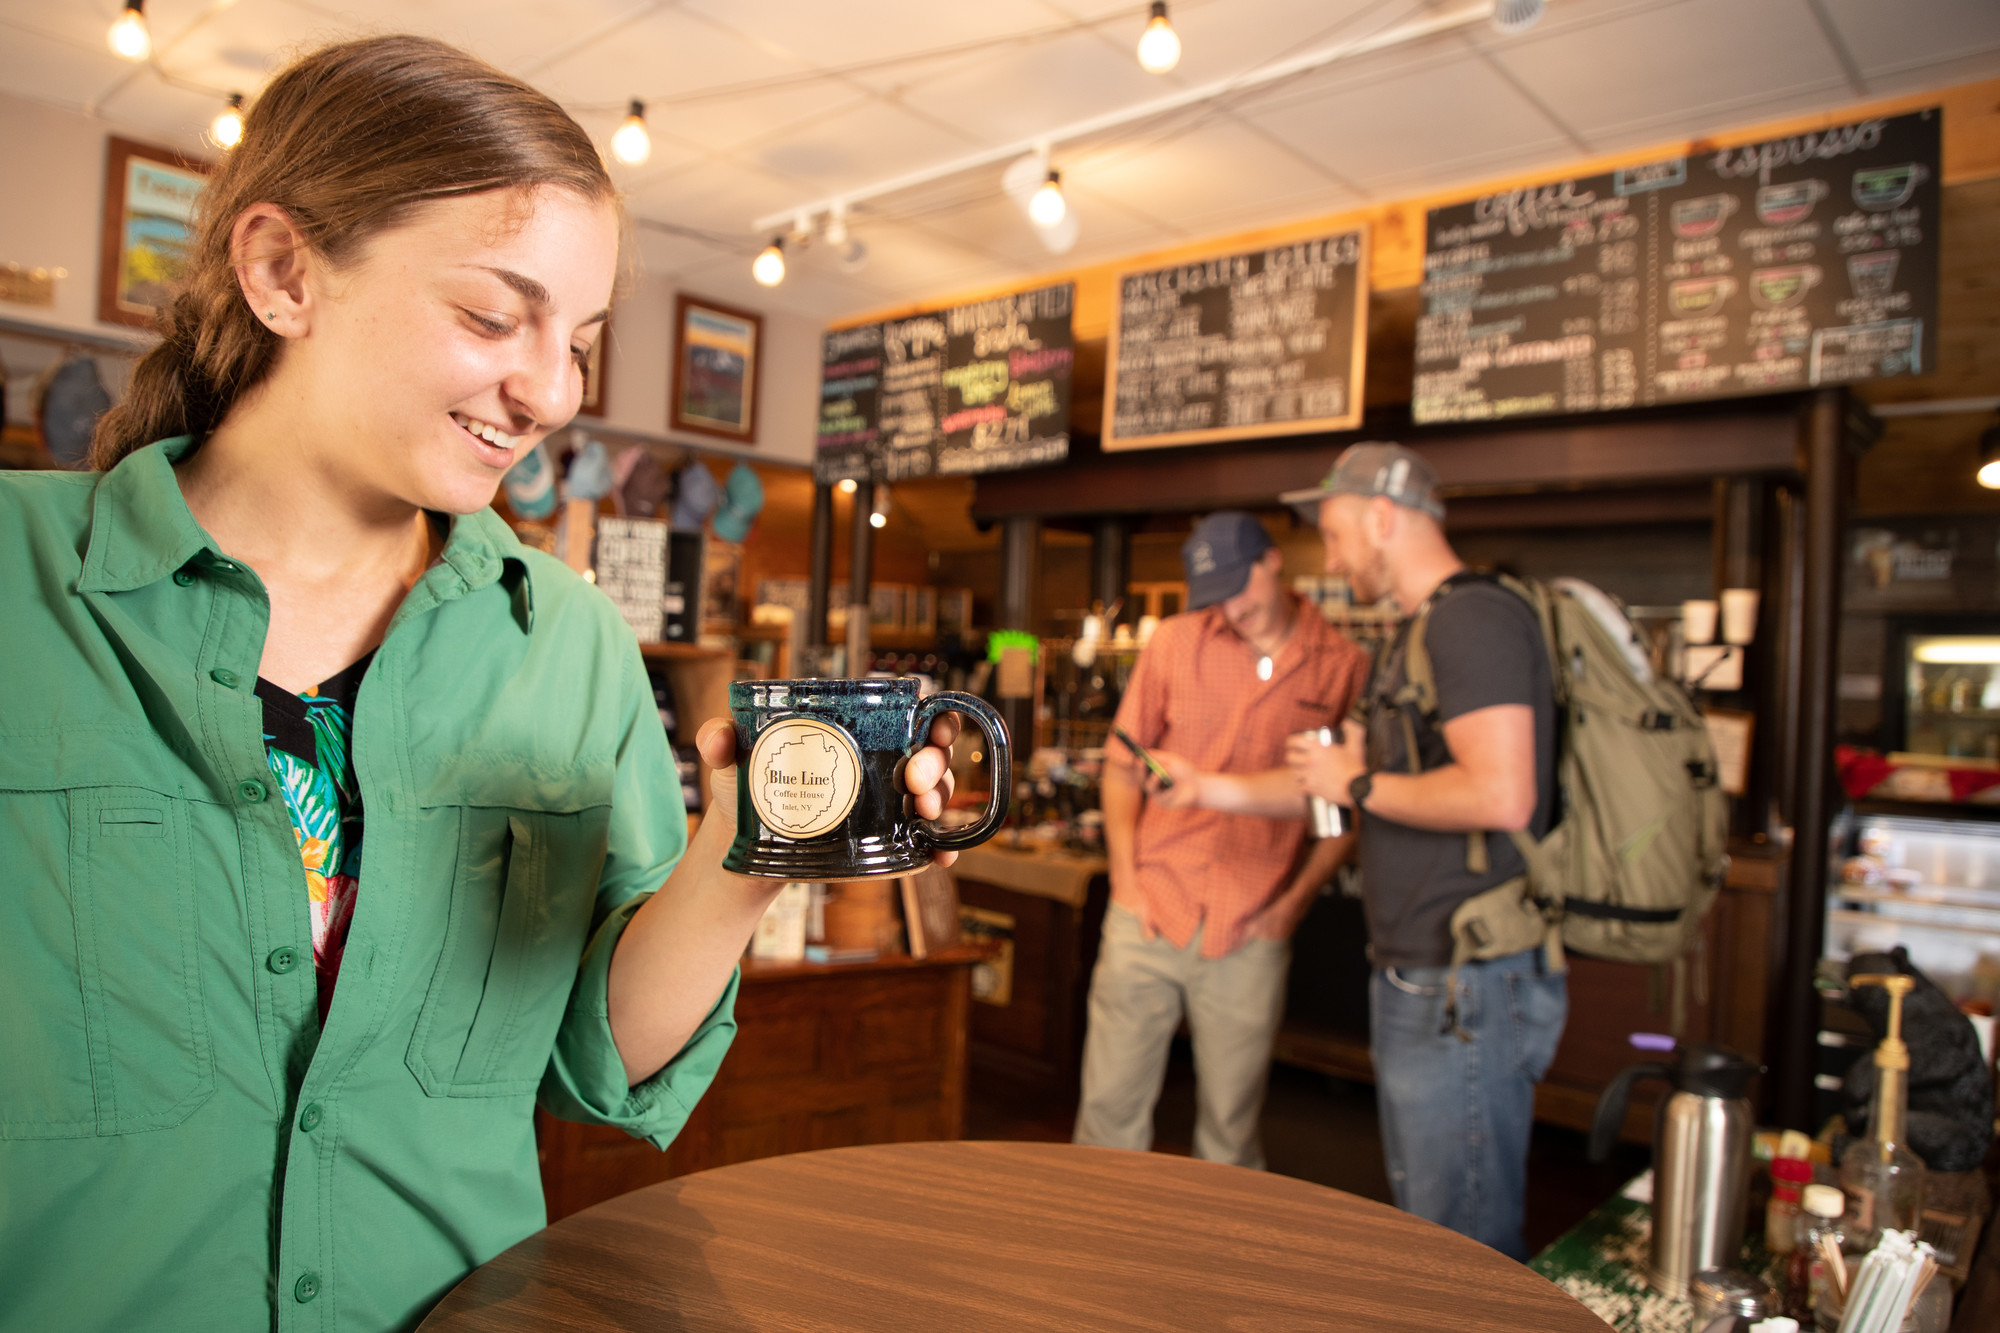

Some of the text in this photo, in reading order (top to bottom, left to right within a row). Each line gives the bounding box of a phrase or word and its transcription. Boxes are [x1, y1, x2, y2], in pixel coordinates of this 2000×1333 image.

[770, 769, 830, 786] Blue Line
[773, 789, 825, 799] Coffee House
[782, 803, 812, 812] Inlet, NY
